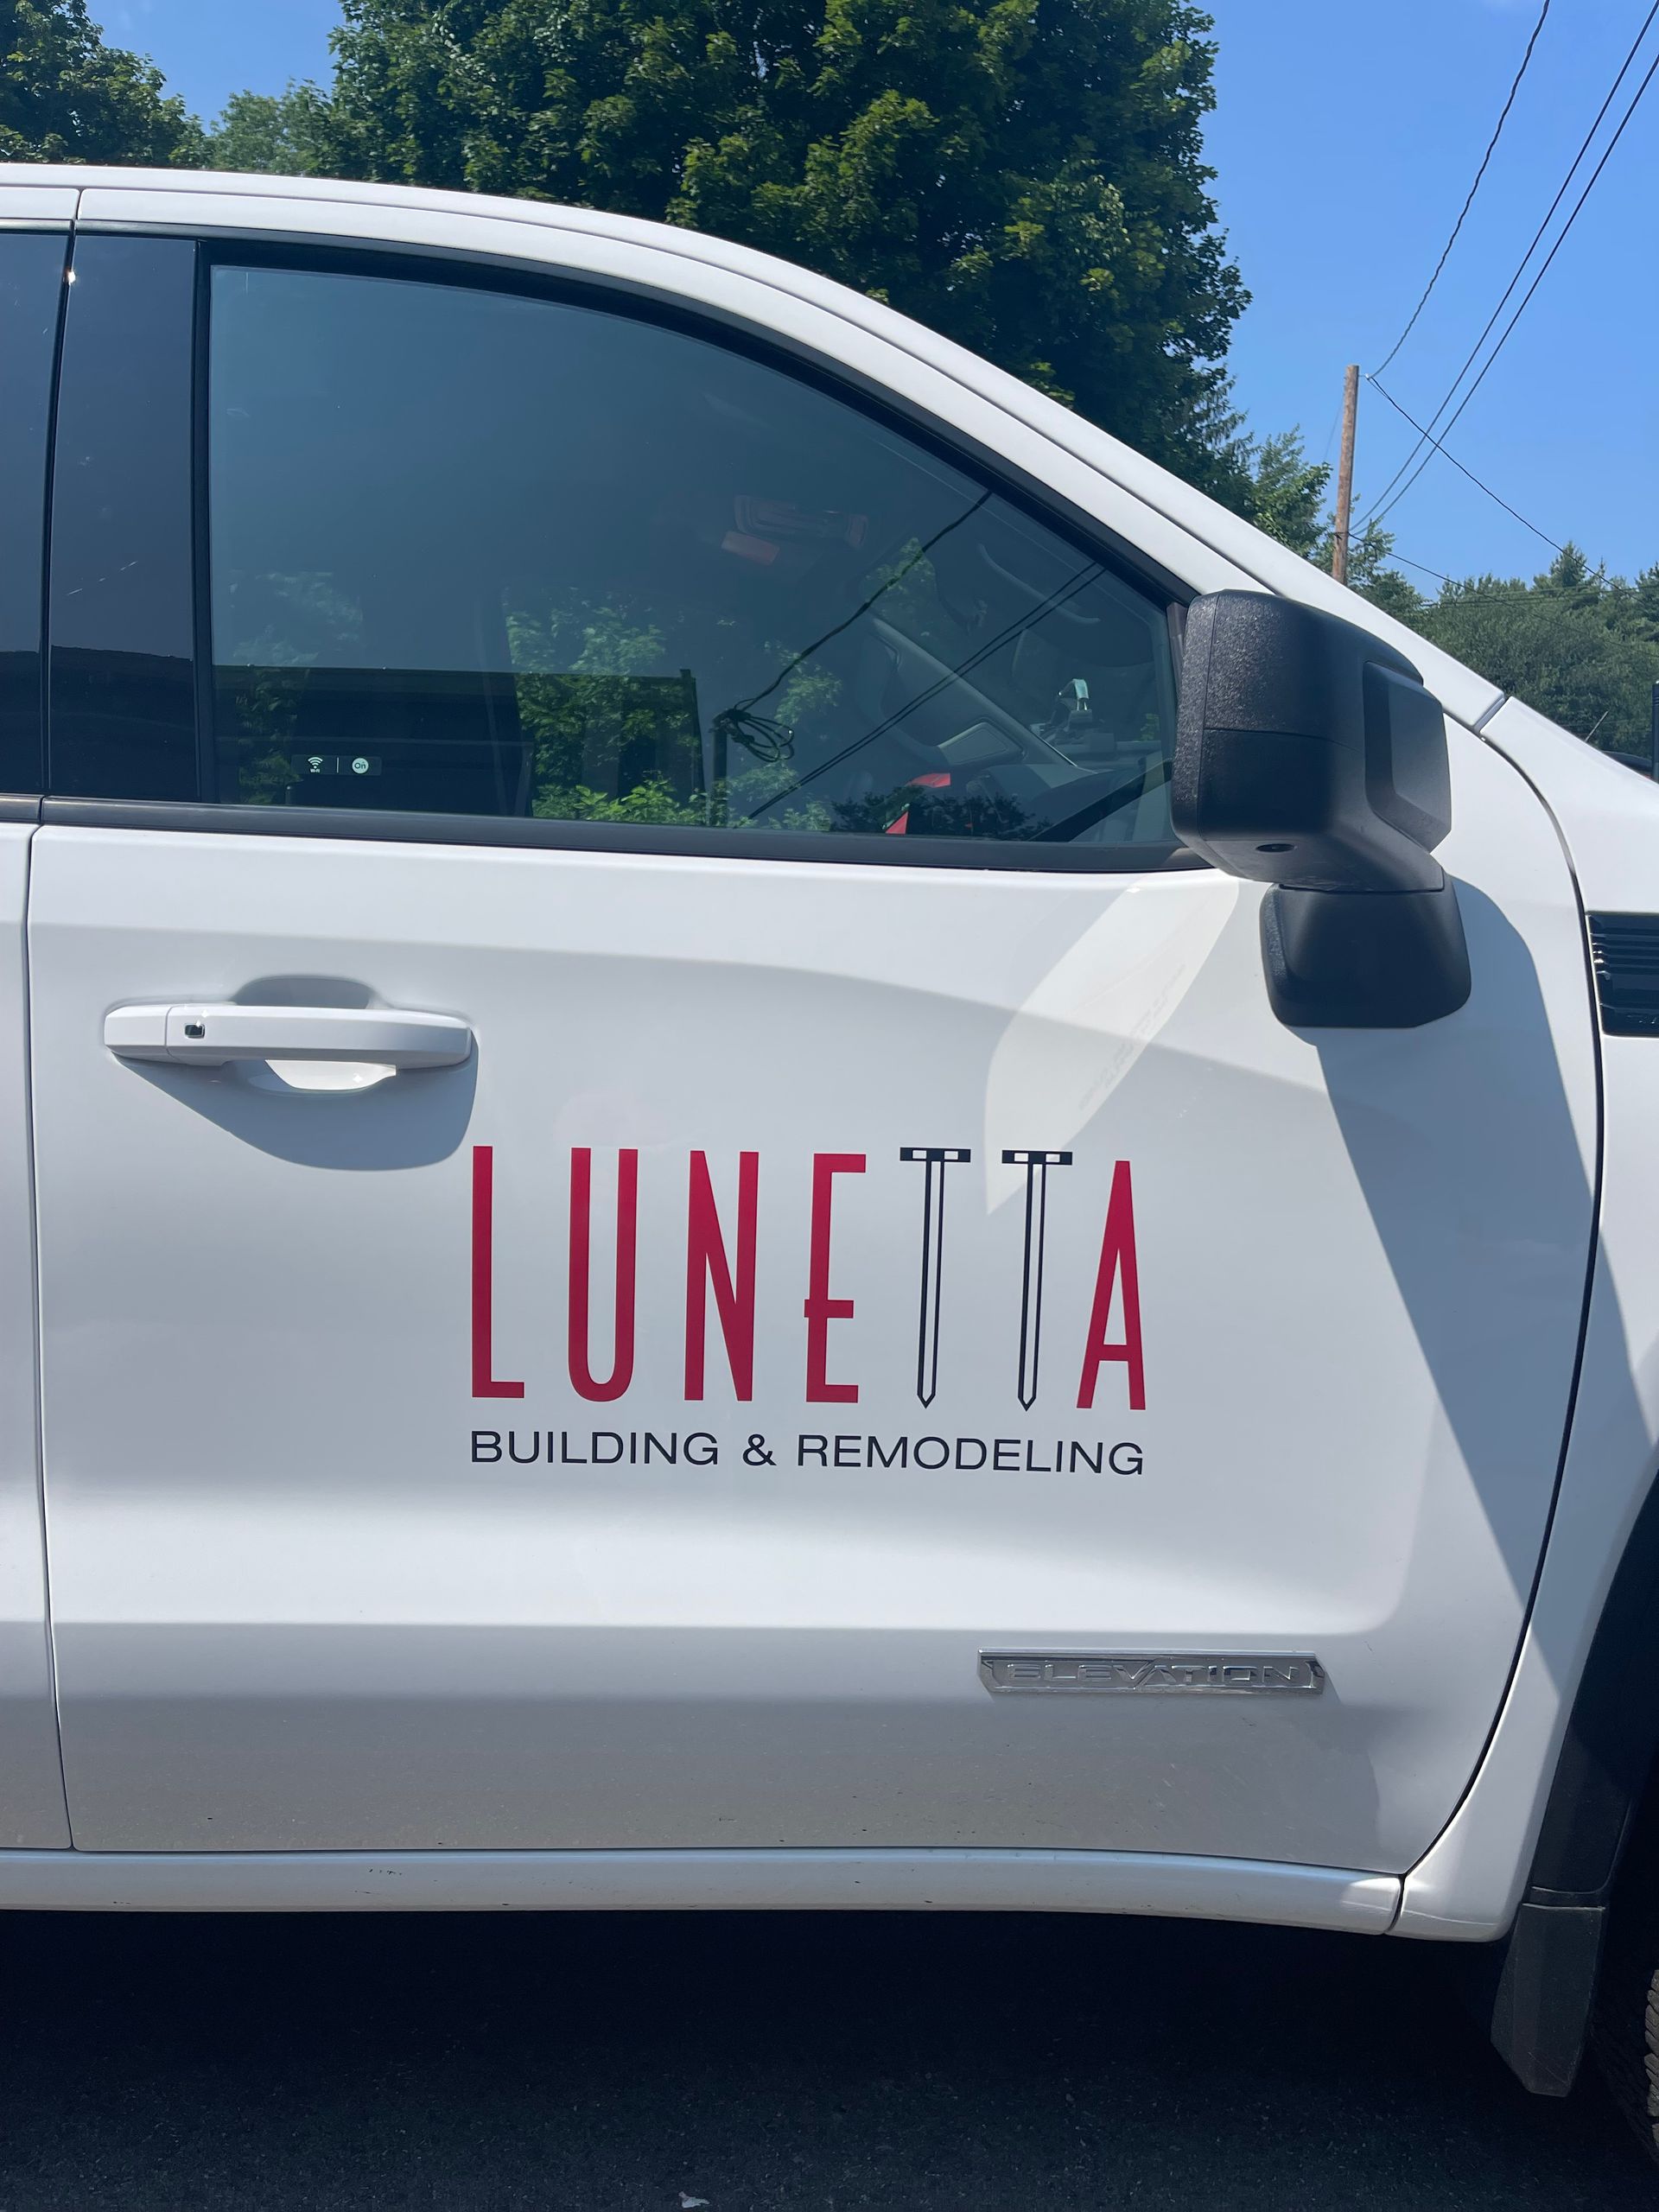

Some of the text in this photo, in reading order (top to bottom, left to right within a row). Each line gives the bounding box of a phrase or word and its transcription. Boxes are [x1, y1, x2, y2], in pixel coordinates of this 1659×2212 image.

[471, 1145, 1147, 1412] LUNETTA
[470, 1429, 1144, 1476] BUILDING & REMODELING
[1007, 1660, 1299, 1685] ELEVATION
